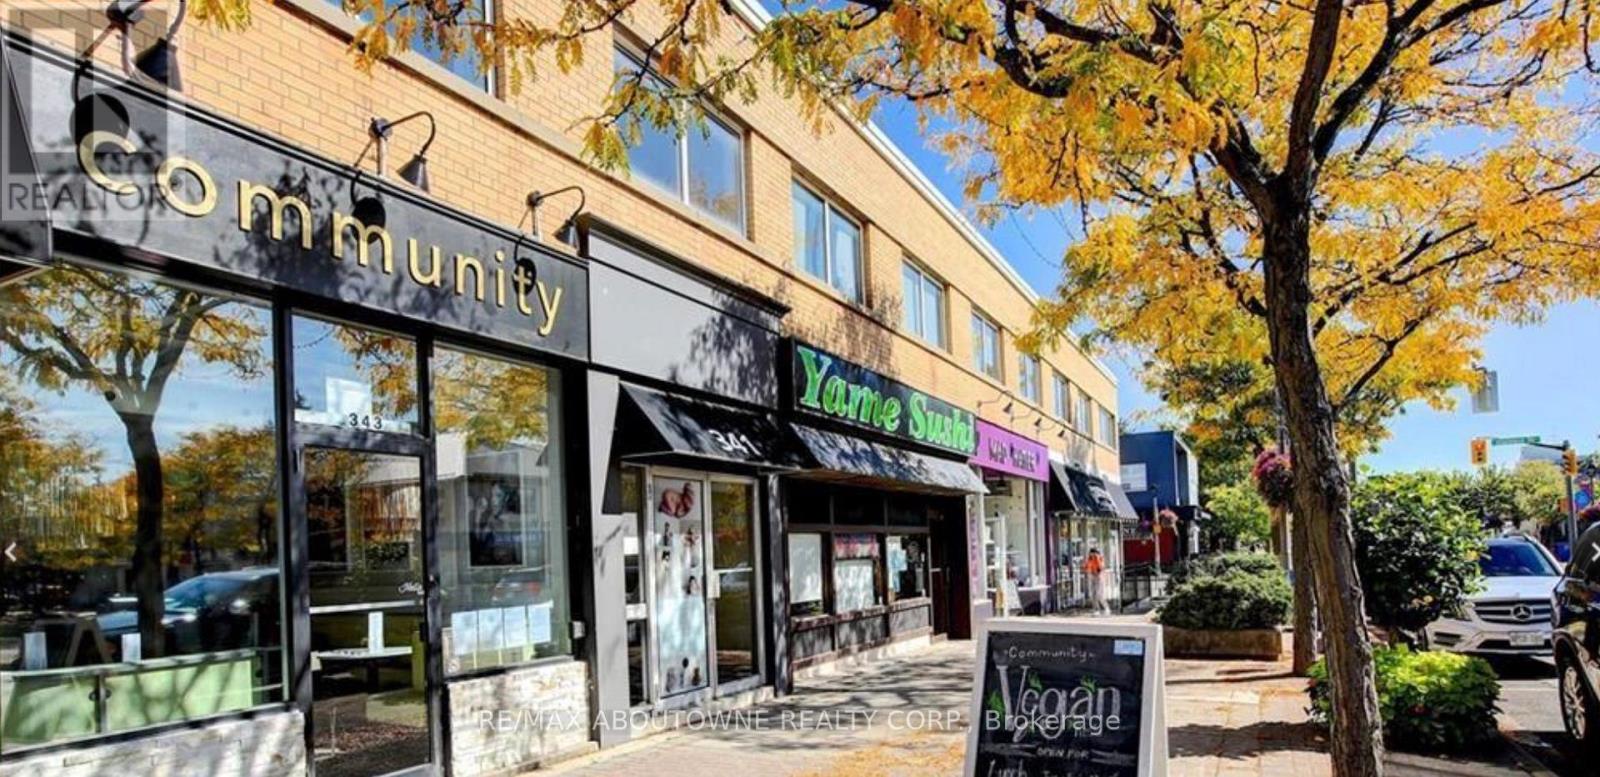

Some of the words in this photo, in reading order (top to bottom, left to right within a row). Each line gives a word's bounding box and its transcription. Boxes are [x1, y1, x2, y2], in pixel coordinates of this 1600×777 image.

[79, 130, 562, 336] Community
[349, 412, 382, 430] 343
[797, 345, 901, 432] Yame
[909, 391, 976, 454] Sushi
[708, 429, 761, 456] 341
[996, 665, 1121, 743] Vegan
